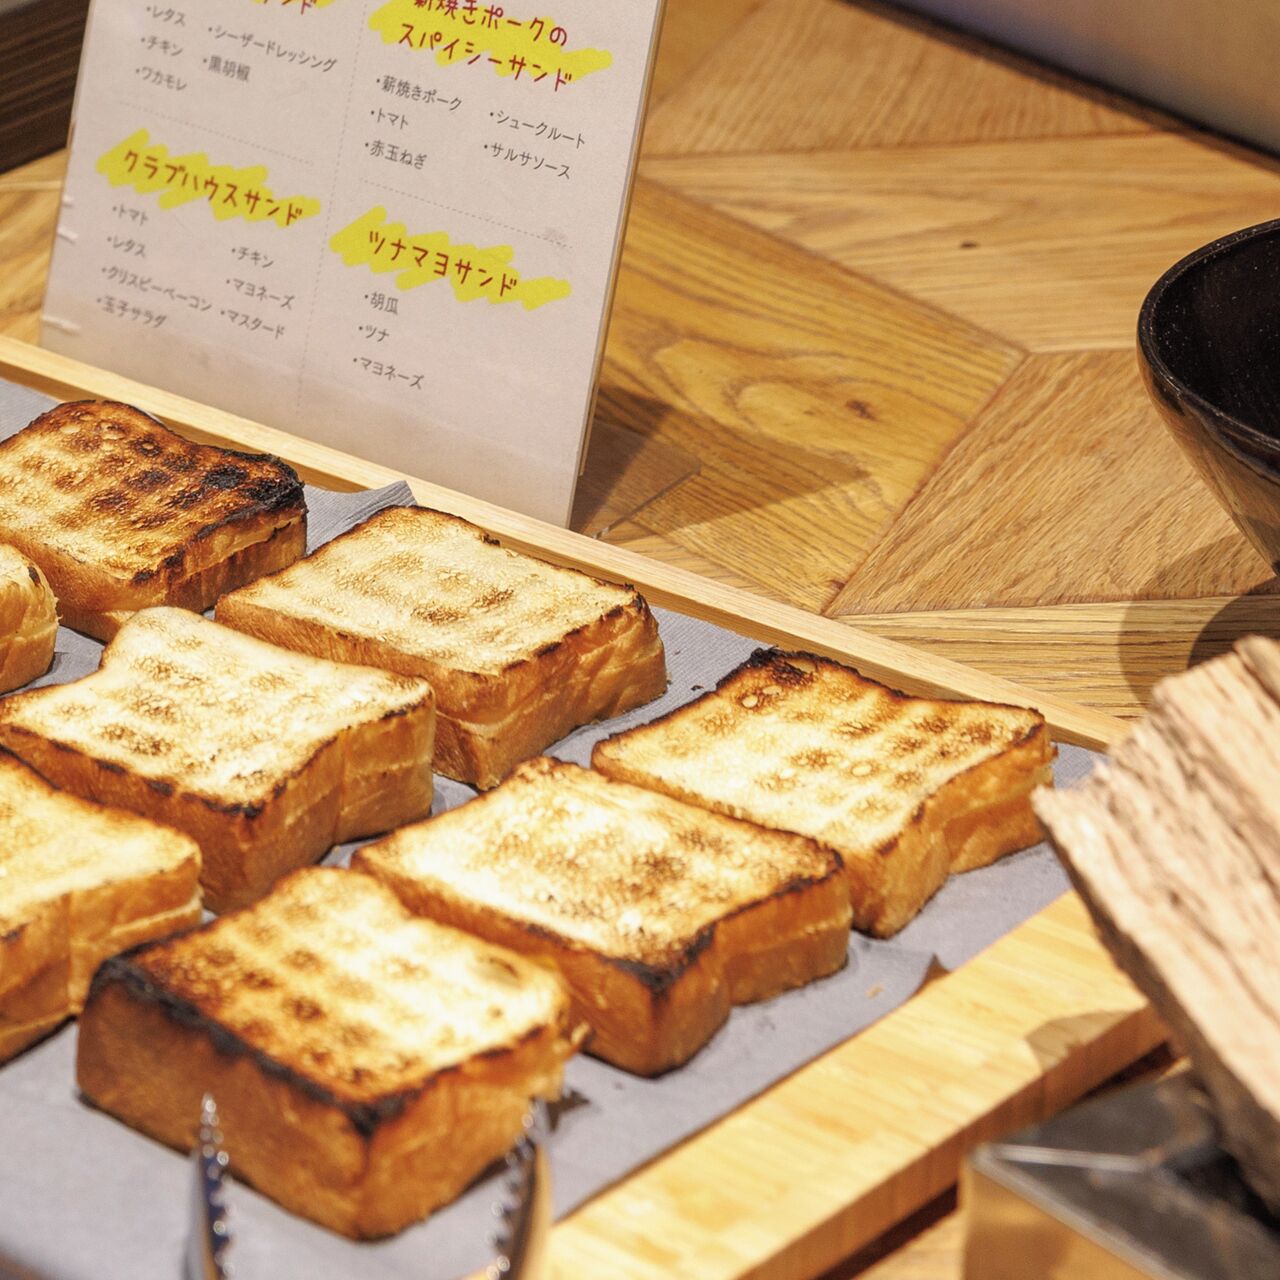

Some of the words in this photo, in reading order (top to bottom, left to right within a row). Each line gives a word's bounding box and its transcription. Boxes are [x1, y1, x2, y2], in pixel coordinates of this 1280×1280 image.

[398, 23, 573, 92] スパイシーサンド
[124, 150, 303, 226] クラブハウスサンド
[369, 230, 518, 297] ツナマヨサンド
